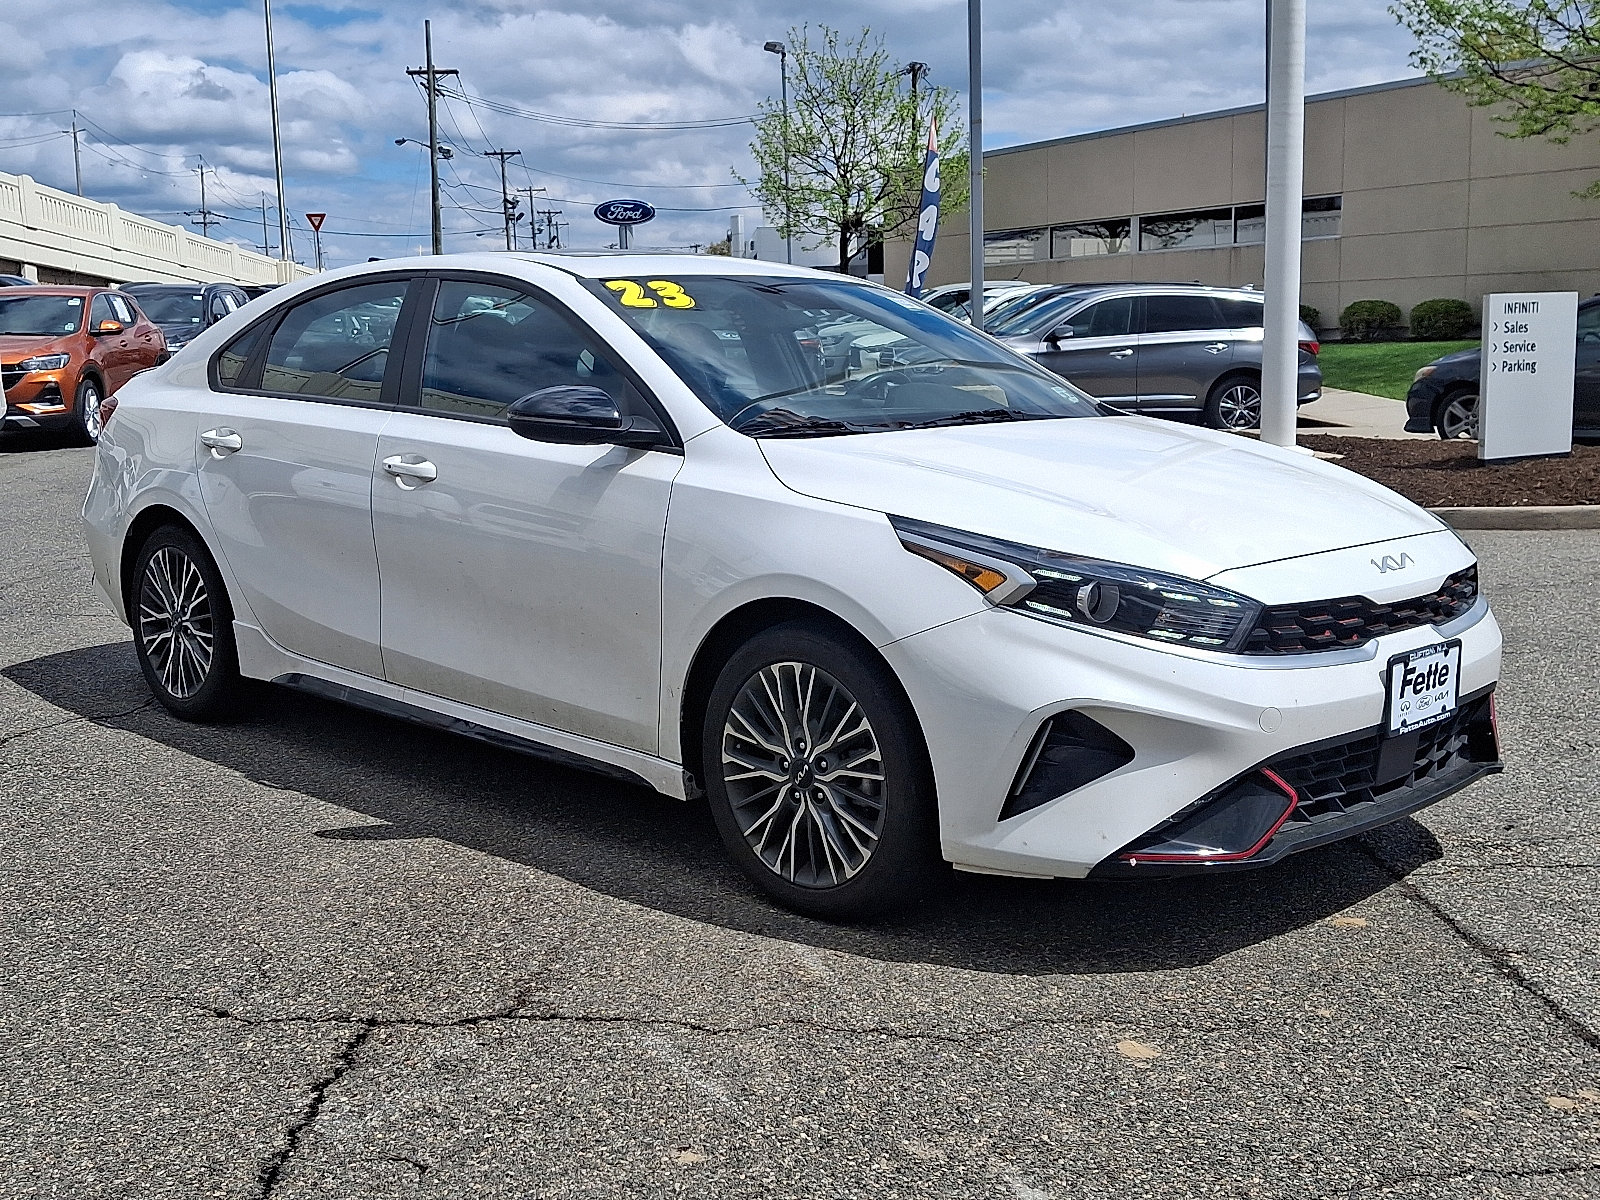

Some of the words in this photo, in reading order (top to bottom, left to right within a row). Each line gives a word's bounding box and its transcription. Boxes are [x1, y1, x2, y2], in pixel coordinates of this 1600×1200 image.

[607, 204, 642, 219] Ford
[604, 279, 697, 309] 23
[1504, 301, 1539, 314] INFINITI
[1503, 321, 1529, 334] Sales
[1502, 340, 1537, 353] Service
[1501, 359, 1537, 374] Parking
[1399, 661, 1450, 700] Fette
